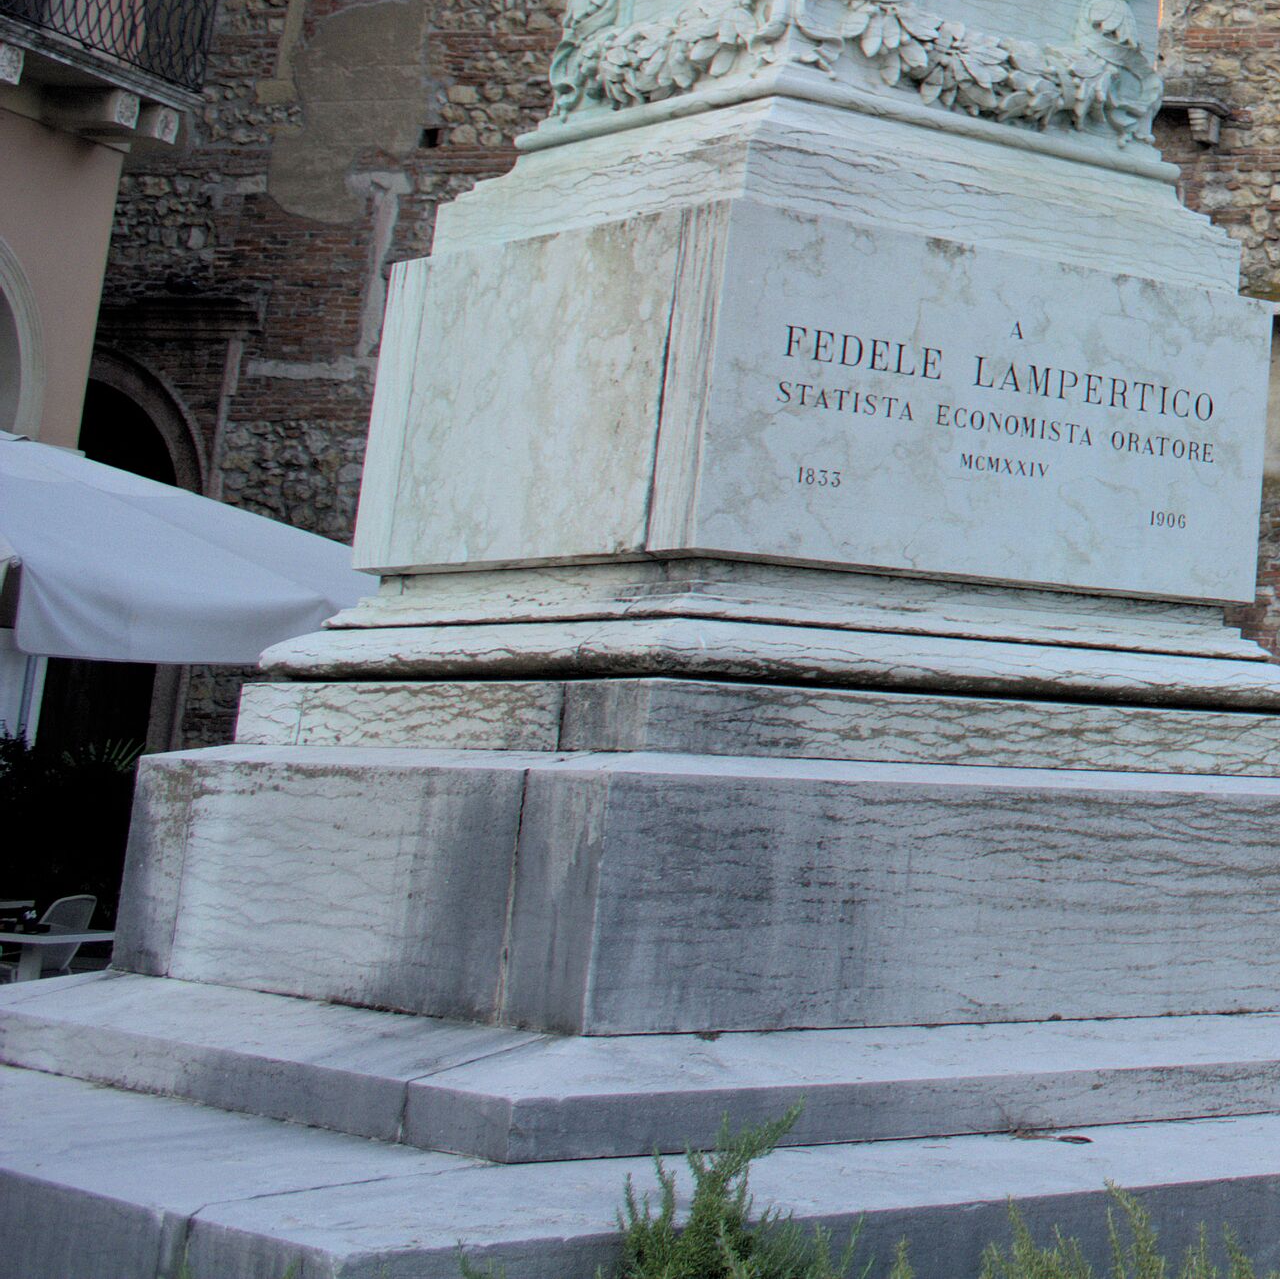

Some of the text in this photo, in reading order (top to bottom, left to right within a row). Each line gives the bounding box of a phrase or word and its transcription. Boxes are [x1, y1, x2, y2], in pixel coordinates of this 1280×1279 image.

[1011, 321, 1024, 340] A
[783, 324, 1215, 422] FEDELE LAMPERTICO
[777, 381, 1215, 464] STATISTA ECONOMISTA ORATORE
[797, 466, 842, 488] 1833
[960, 452, 1050, 478] MCMXXIV
[1150, 510, 1187, 529] 1906
